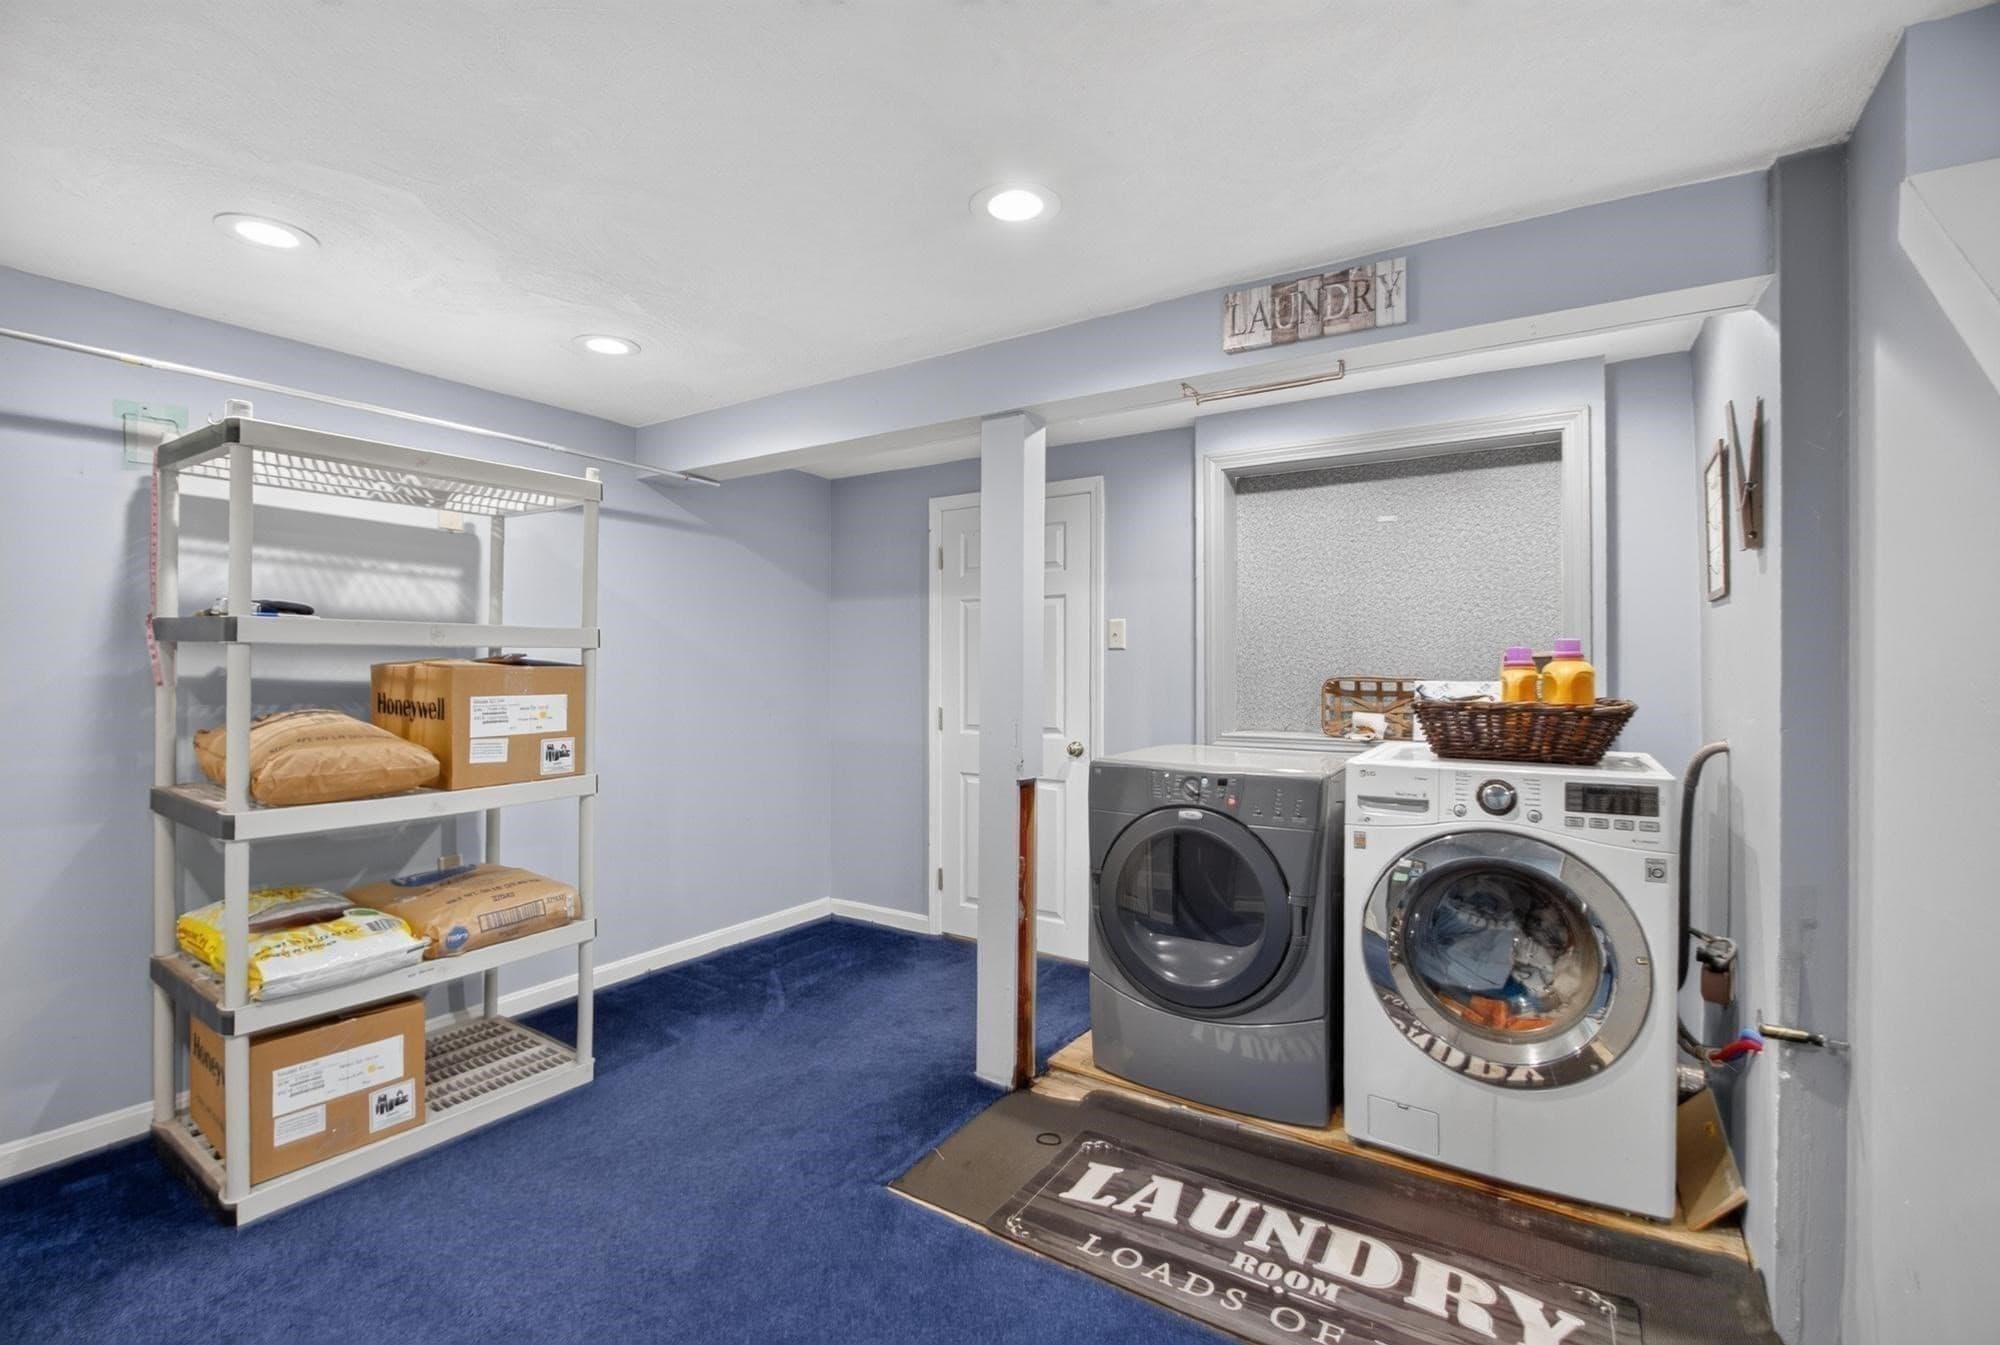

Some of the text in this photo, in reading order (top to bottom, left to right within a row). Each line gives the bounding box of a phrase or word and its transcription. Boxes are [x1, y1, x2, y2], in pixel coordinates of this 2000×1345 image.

[1229, 270, 1404, 337] LAUNDRY
[377, 692, 445, 722] Honeywell
[1059, 1162, 1585, 1345] LAUNDRY
[1229, 1251, 1341, 1303] ROOM
[1077, 1233, 1345, 1345] LOADS OF
